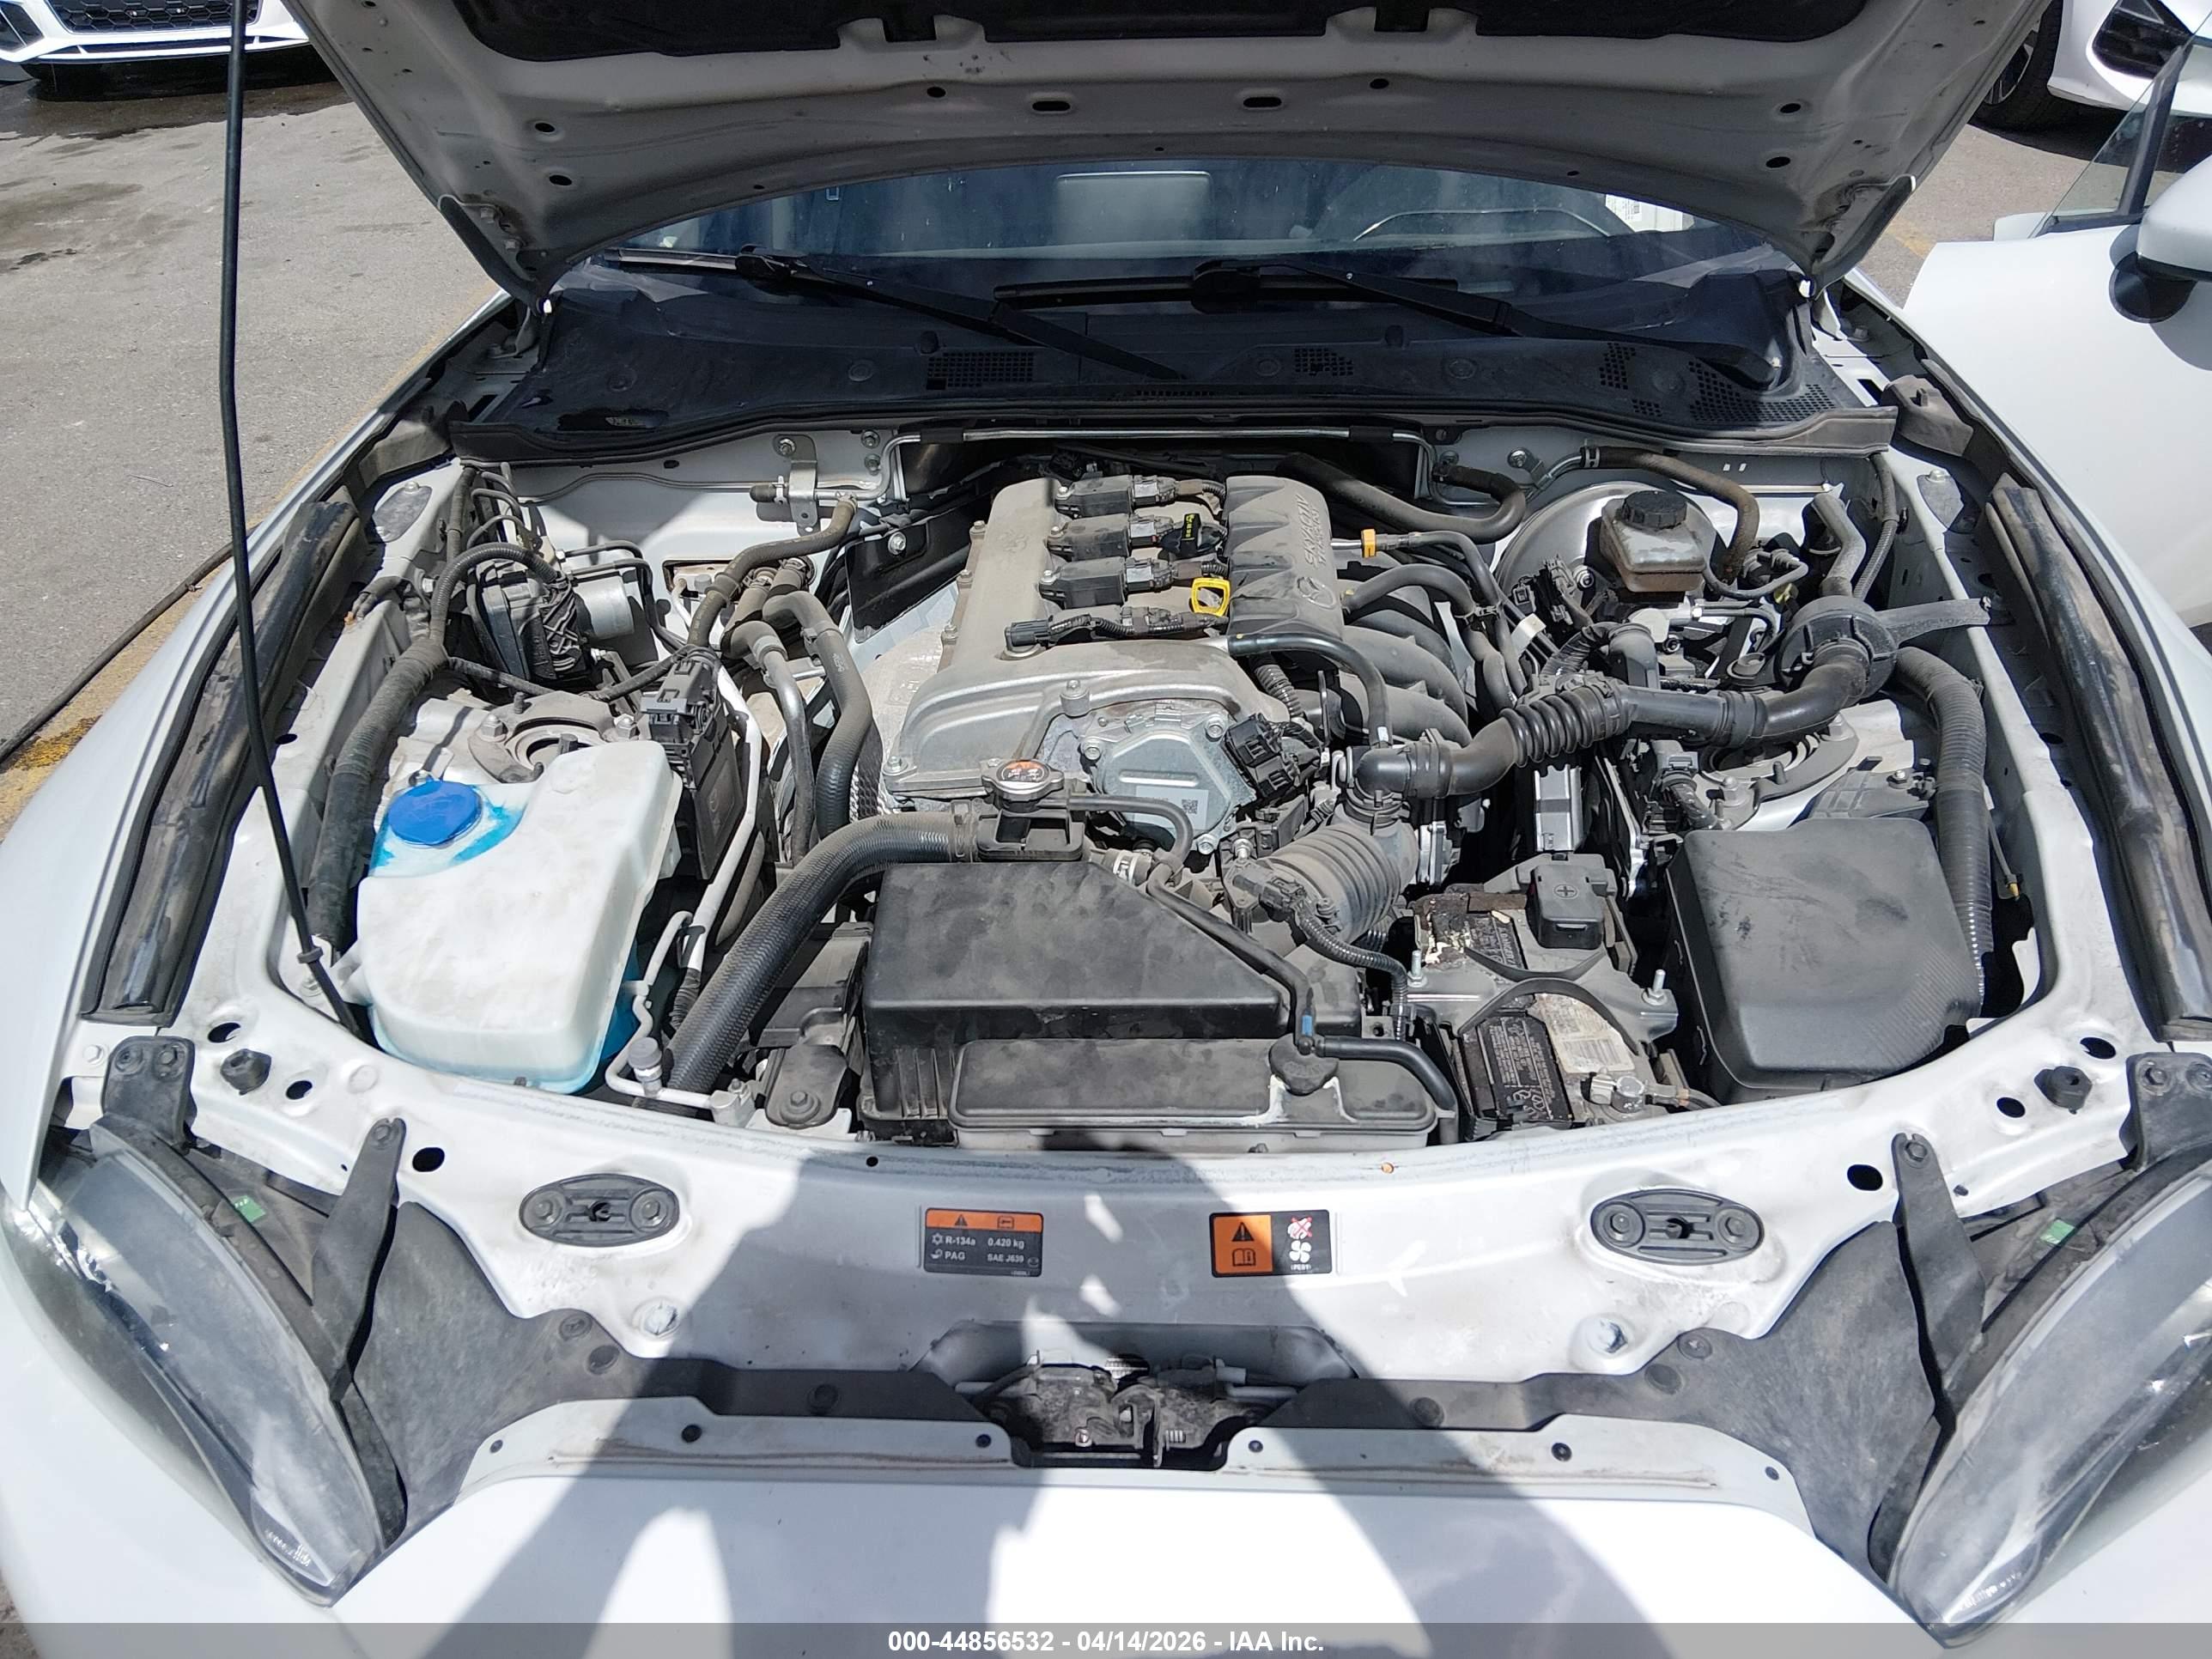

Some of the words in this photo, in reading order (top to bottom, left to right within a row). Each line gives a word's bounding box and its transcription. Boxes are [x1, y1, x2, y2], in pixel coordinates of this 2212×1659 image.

[945, 1236, 976, 1247] R-134a
[988, 1237, 1012, 1248] 0.420
[1013, 1238, 1025, 1250] kg
[945, 1250, 966, 1261] PAG
[987, 1253, 1004, 1262] SAE
[1006, 1255, 1024, 1264] J639
